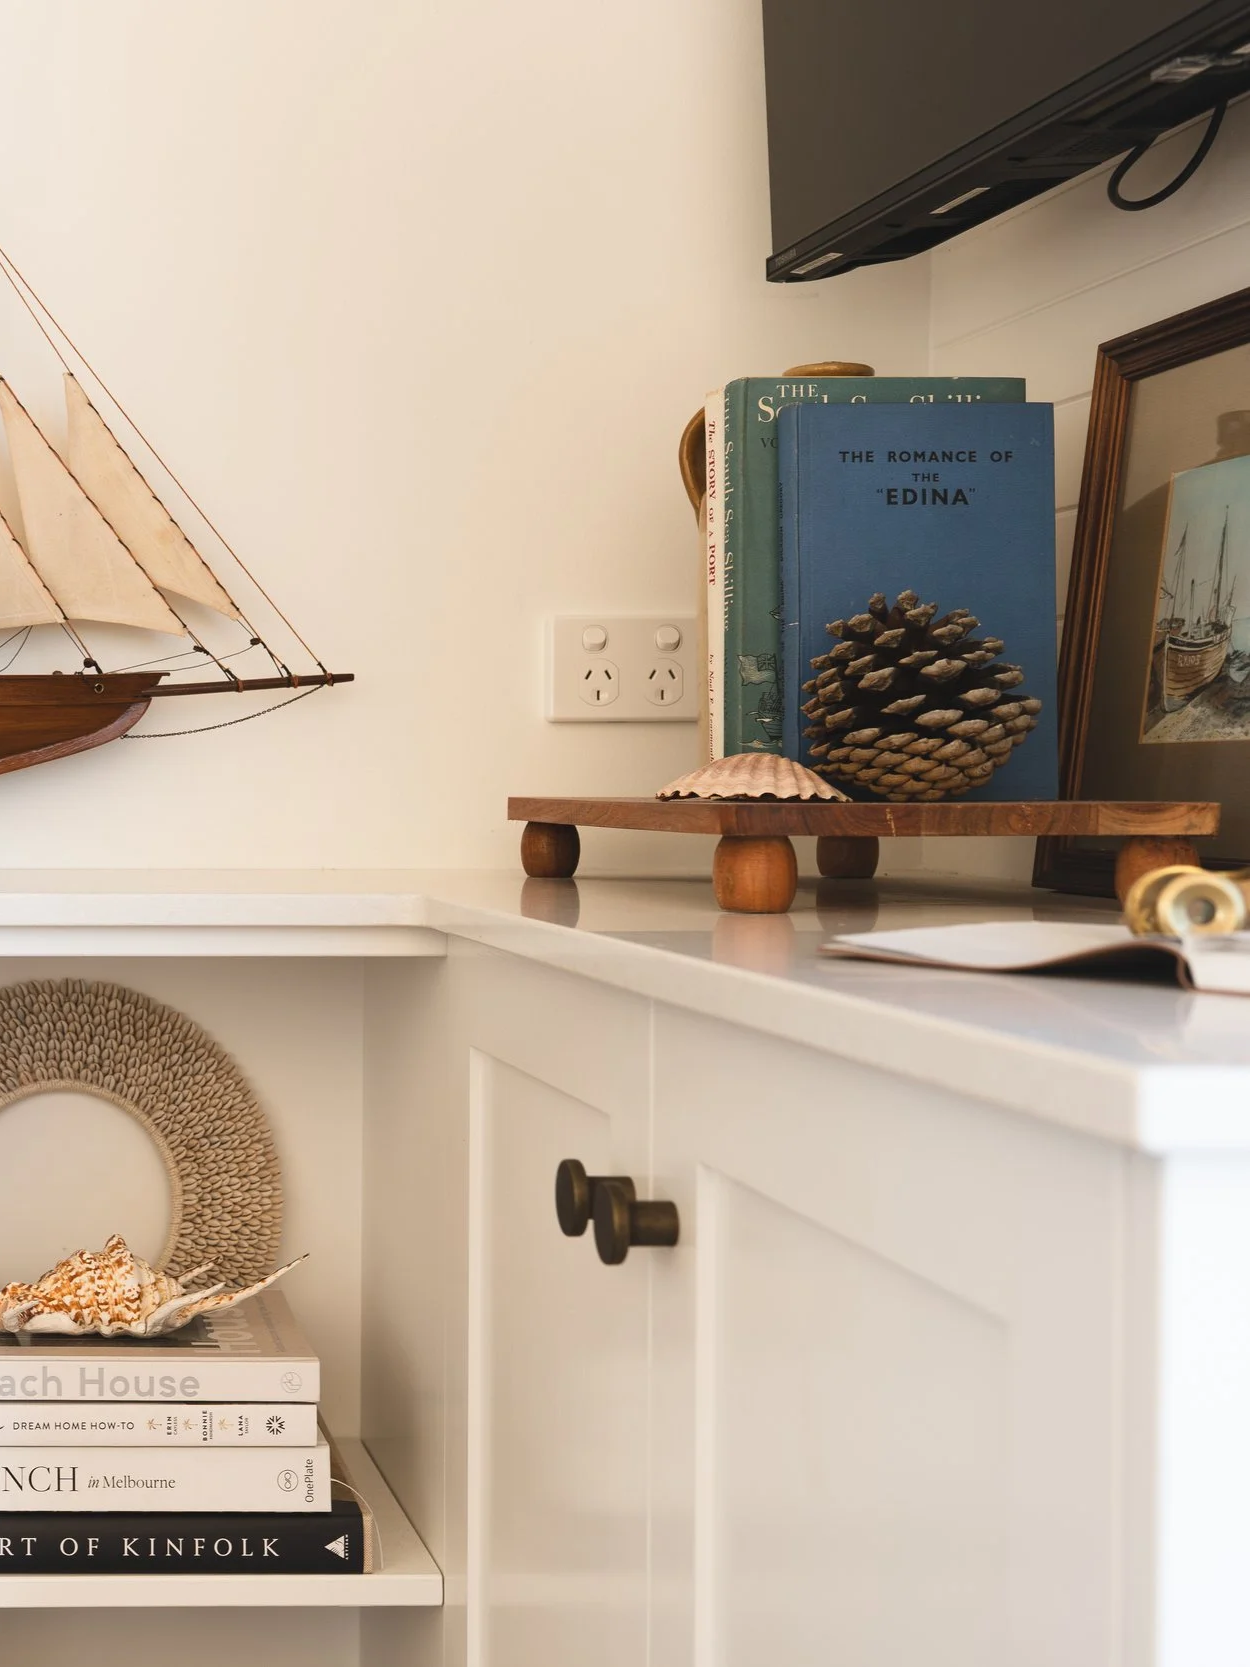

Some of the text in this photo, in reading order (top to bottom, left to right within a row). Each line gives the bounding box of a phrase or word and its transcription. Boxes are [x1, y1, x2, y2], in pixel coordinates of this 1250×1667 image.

[776, 384, 819, 398] THE
[838, 450, 1013, 463] THE ROMANCE OF
[708, 449, 717, 500] STORY
[911, 472, 940, 482] THE
[708, 544, 716, 586] PORT
[191, 1307, 262, 1354] Hous
[79, 1366, 201, 1398] House
[12, 1420, 135, 1431] DREAM HOME HOW-TO
[87, 1475, 100, 1489] in
[102, 1474, 176, 1489] Melbourne
[304, 1458, 314, 1503] OnePlate
[59, 1536, 100, 1557] OF
[122, 1536, 281, 1557] KINFOLK
